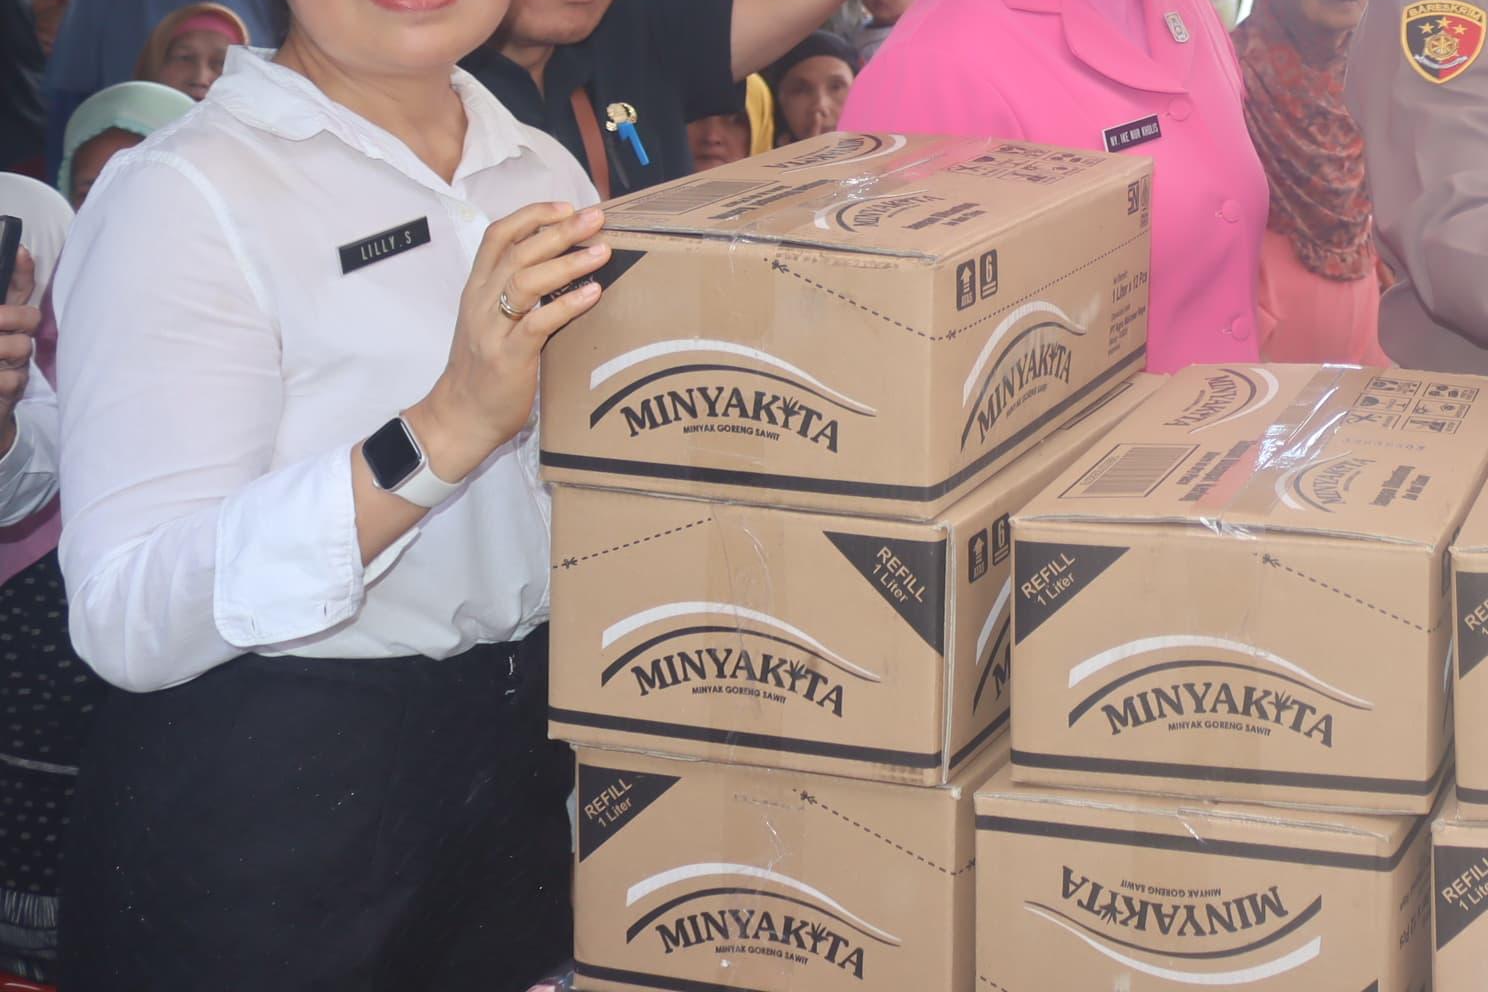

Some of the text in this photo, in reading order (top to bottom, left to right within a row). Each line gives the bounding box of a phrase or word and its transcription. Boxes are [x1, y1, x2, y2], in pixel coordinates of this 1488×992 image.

[977, 343, 1072, 444] MINYAKITA
[620, 386, 839, 454] MINYAKITA
[683, 424, 780, 441] MINYAK GORENG SAWIT
[873, 564, 909, 603] 1 Liter
[877, 546, 926, 603] REFILL
[1021, 553, 1076, 599] REFILL
[1037, 572, 1075, 606] 1 Liter
[630, 648, 844, 718] MINYAKITA
[692, 685, 787, 704] MINYAK GORENG SAWIT
[1100, 682, 1333, 748] MINYAKITA
[1168, 720, 1271, 737] MINYAK GORENG SAWIT
[584, 778, 632, 820] REFILL
[598, 797, 632, 828] 1 Liter
[1061, 865, 1289, 937] MINYAKITA
[1120, 879, 1222, 898] MINYAK GORENG SAWIT
[1459, 900, 1469, 912] 1
[655, 909, 865, 980] MINYAKITA
[715, 945, 809, 966] MINYAK GORENG SAWIT
